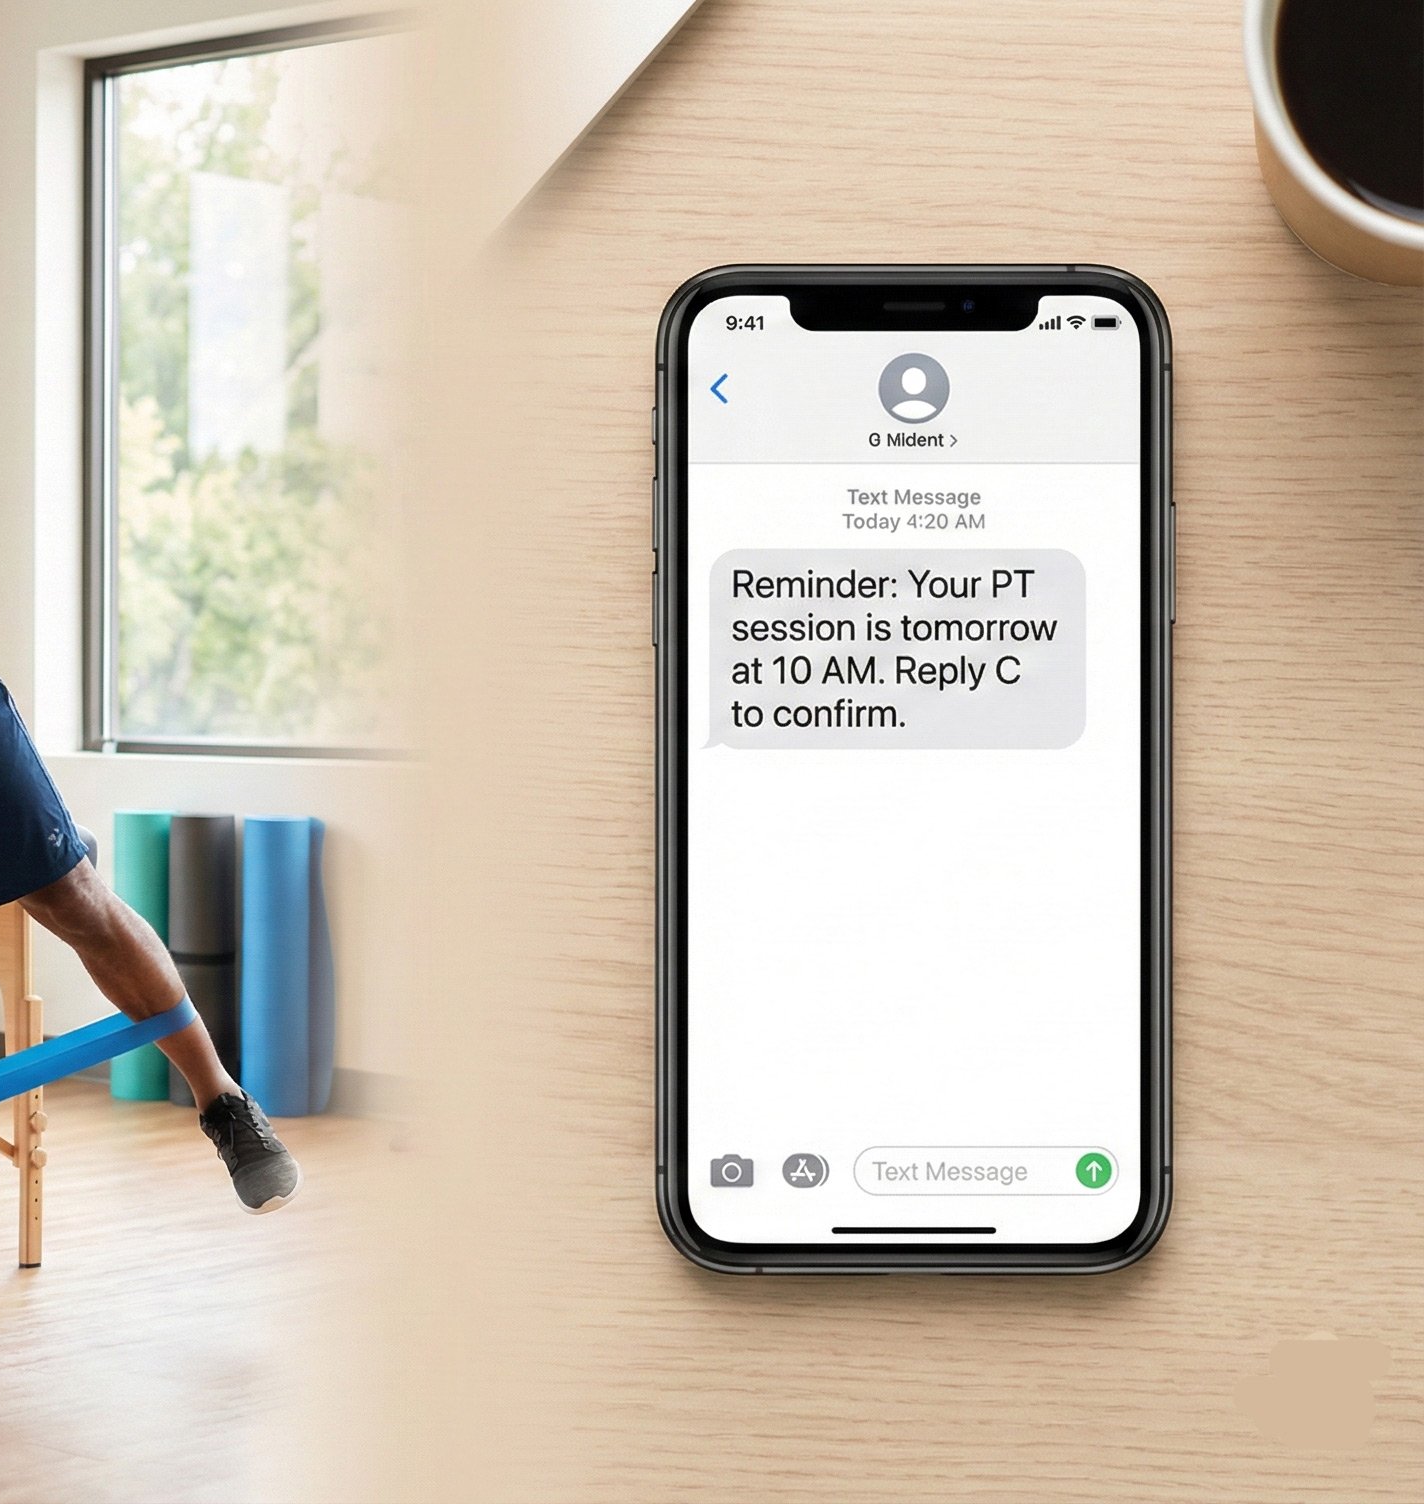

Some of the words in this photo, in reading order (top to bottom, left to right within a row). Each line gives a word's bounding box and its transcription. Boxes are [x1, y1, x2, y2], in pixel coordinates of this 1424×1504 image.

[725, 315, 764, 331] 9:41
[846, 488, 889, 506] Text
[894, 488, 982, 510] Message
[841, 512, 901, 534] Today
[906, 513, 949, 530] 4:20
[954, 513, 985, 530] AM
[733, 568, 897, 599] Reminder:
[907, 569, 982, 599] Your
[992, 569, 1036, 599] PT
[732, 612, 856, 642] session
[866, 612, 892, 642] is
[900, 615, 1058, 642] tomorrow
[731, 657, 763, 685] at
[772, 655, 812, 685] 10
[821, 655, 885, 685] AM.
[895, 655, 987, 692] Reply
[995, 655, 1021, 685] C
[730, 700, 764, 728] to
[773, 697, 906, 728] confirm.
[871, 1161, 919, 1182] Text
[926, 1161, 1028, 1186] Message
